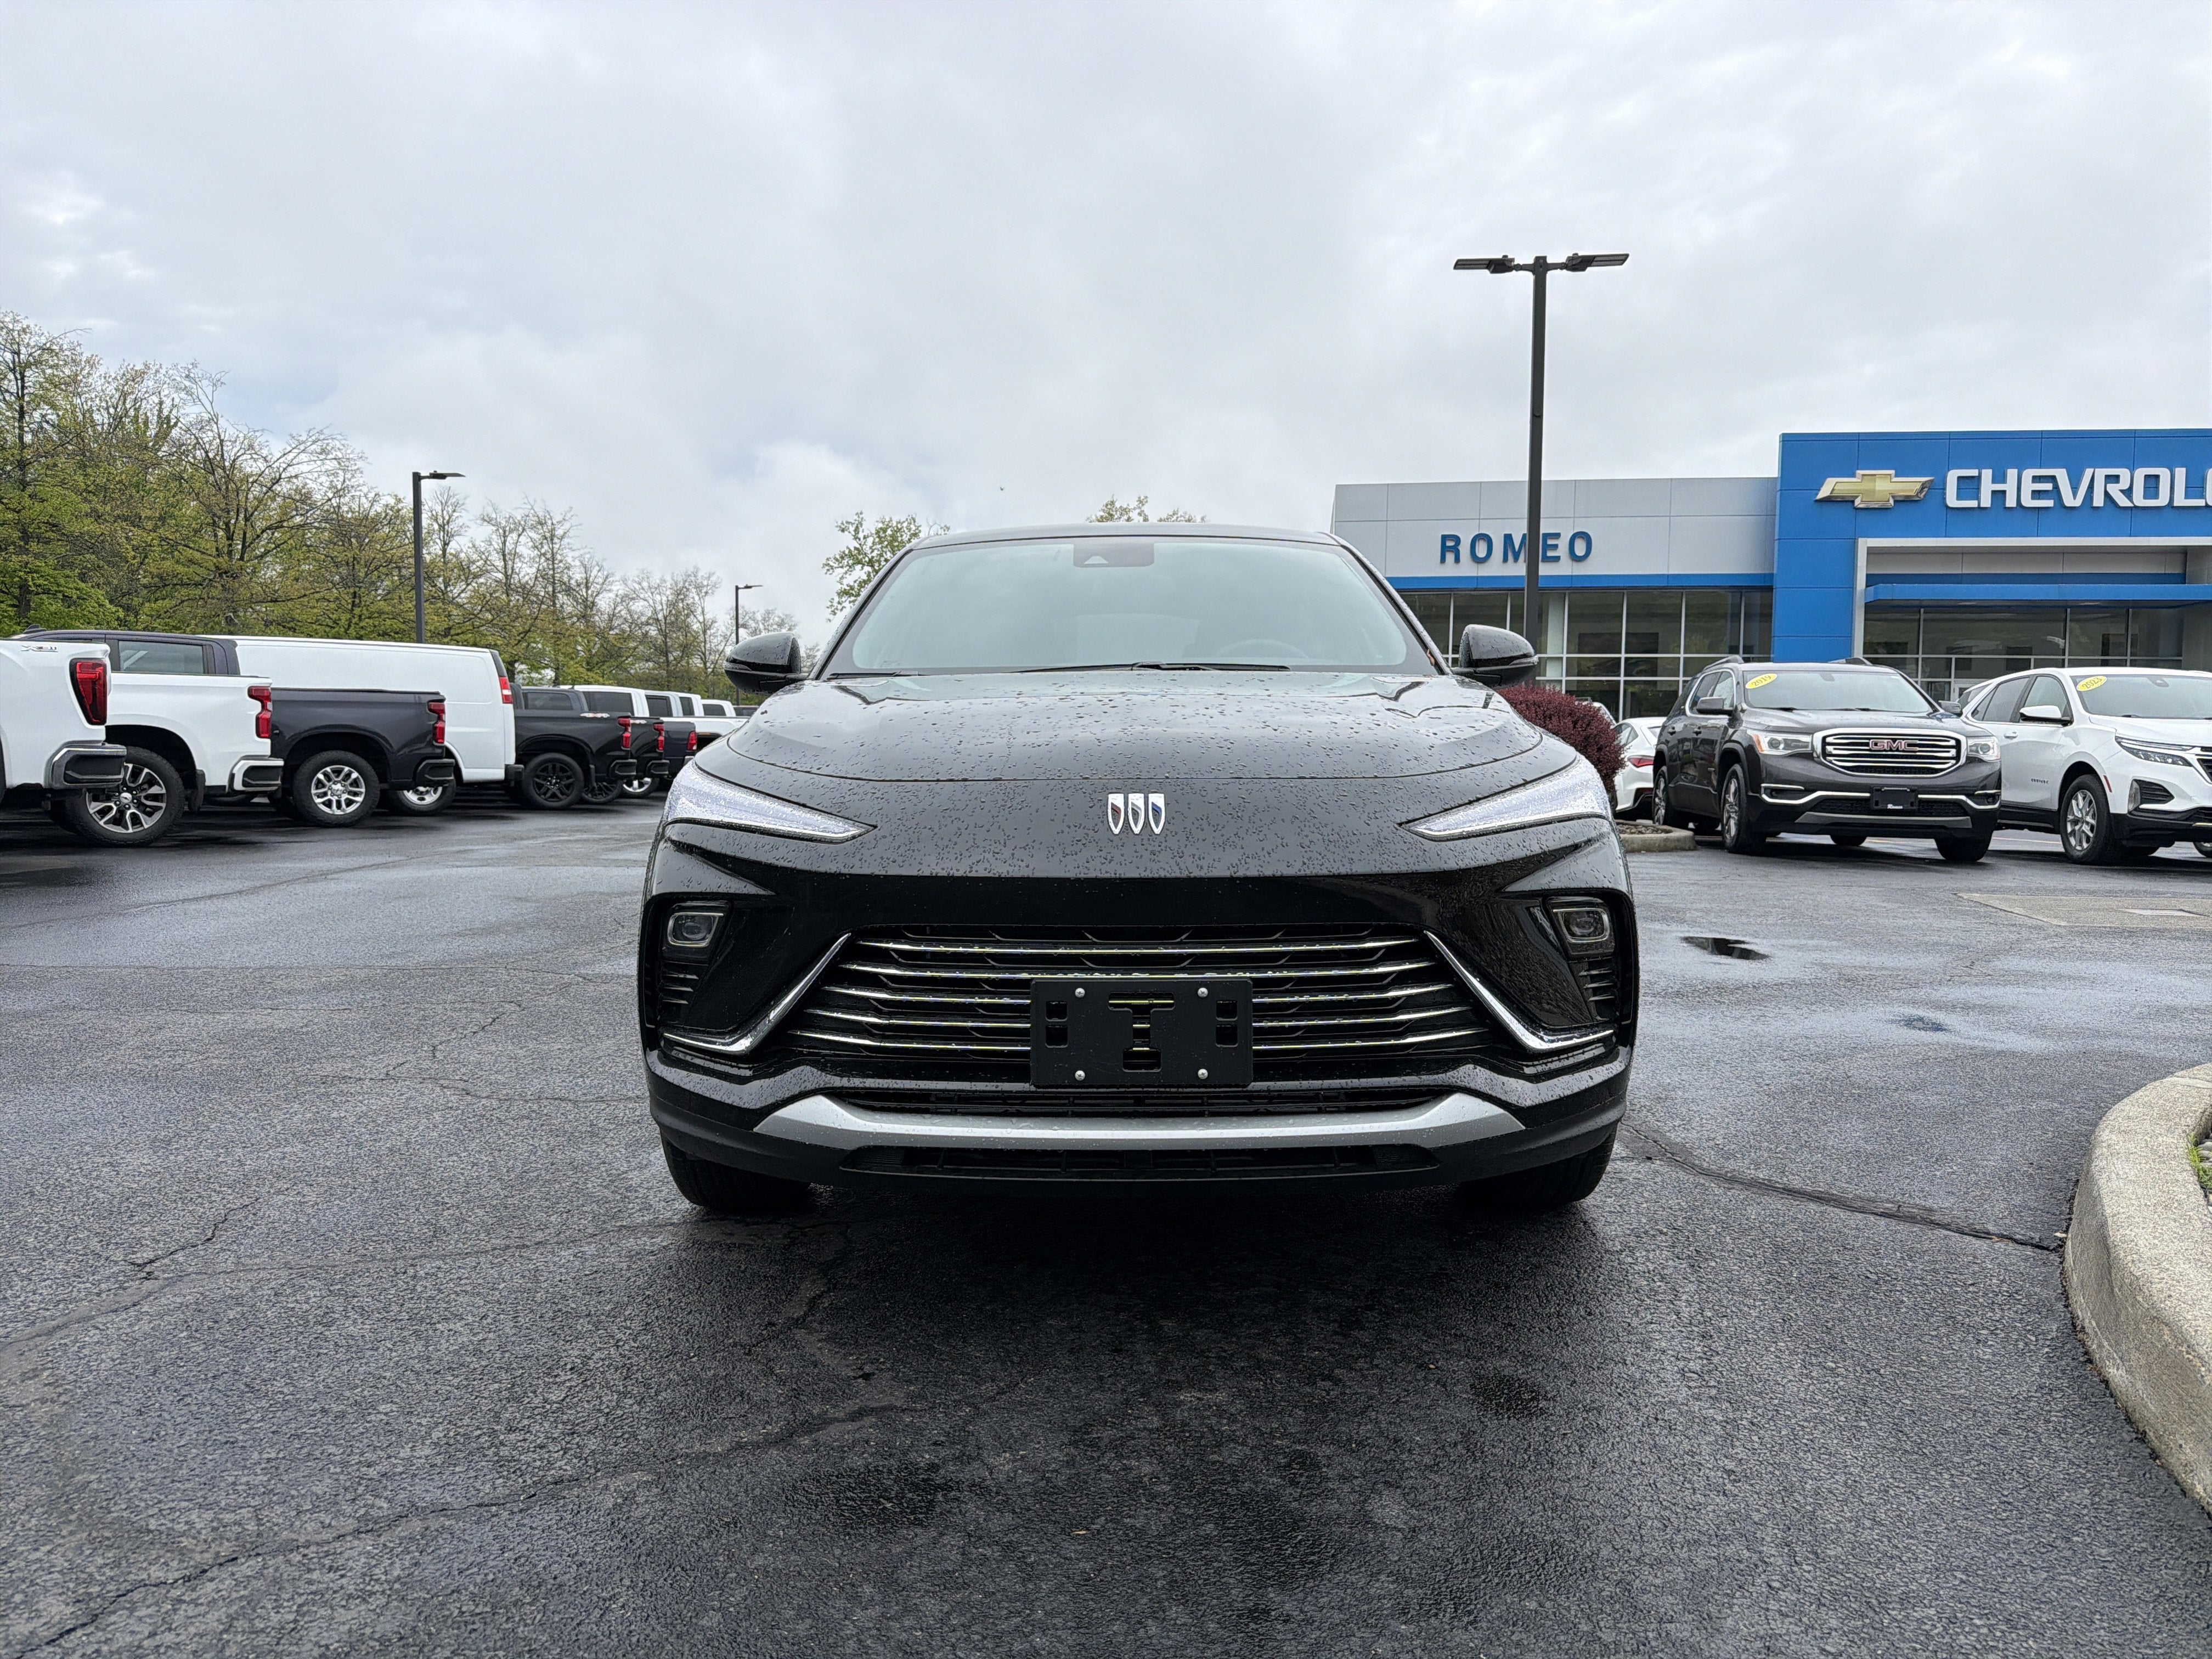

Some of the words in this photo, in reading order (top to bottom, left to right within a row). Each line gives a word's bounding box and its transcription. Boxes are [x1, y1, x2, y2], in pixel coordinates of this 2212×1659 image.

[1946, 467, 2212, 508] CHEVROL
[1440, 531, 1593, 563] ROMEO
[1751, 675, 1771, 686] 2019
[2082, 677, 2102, 689] 2023
[1870, 739, 1918, 751] GMC
